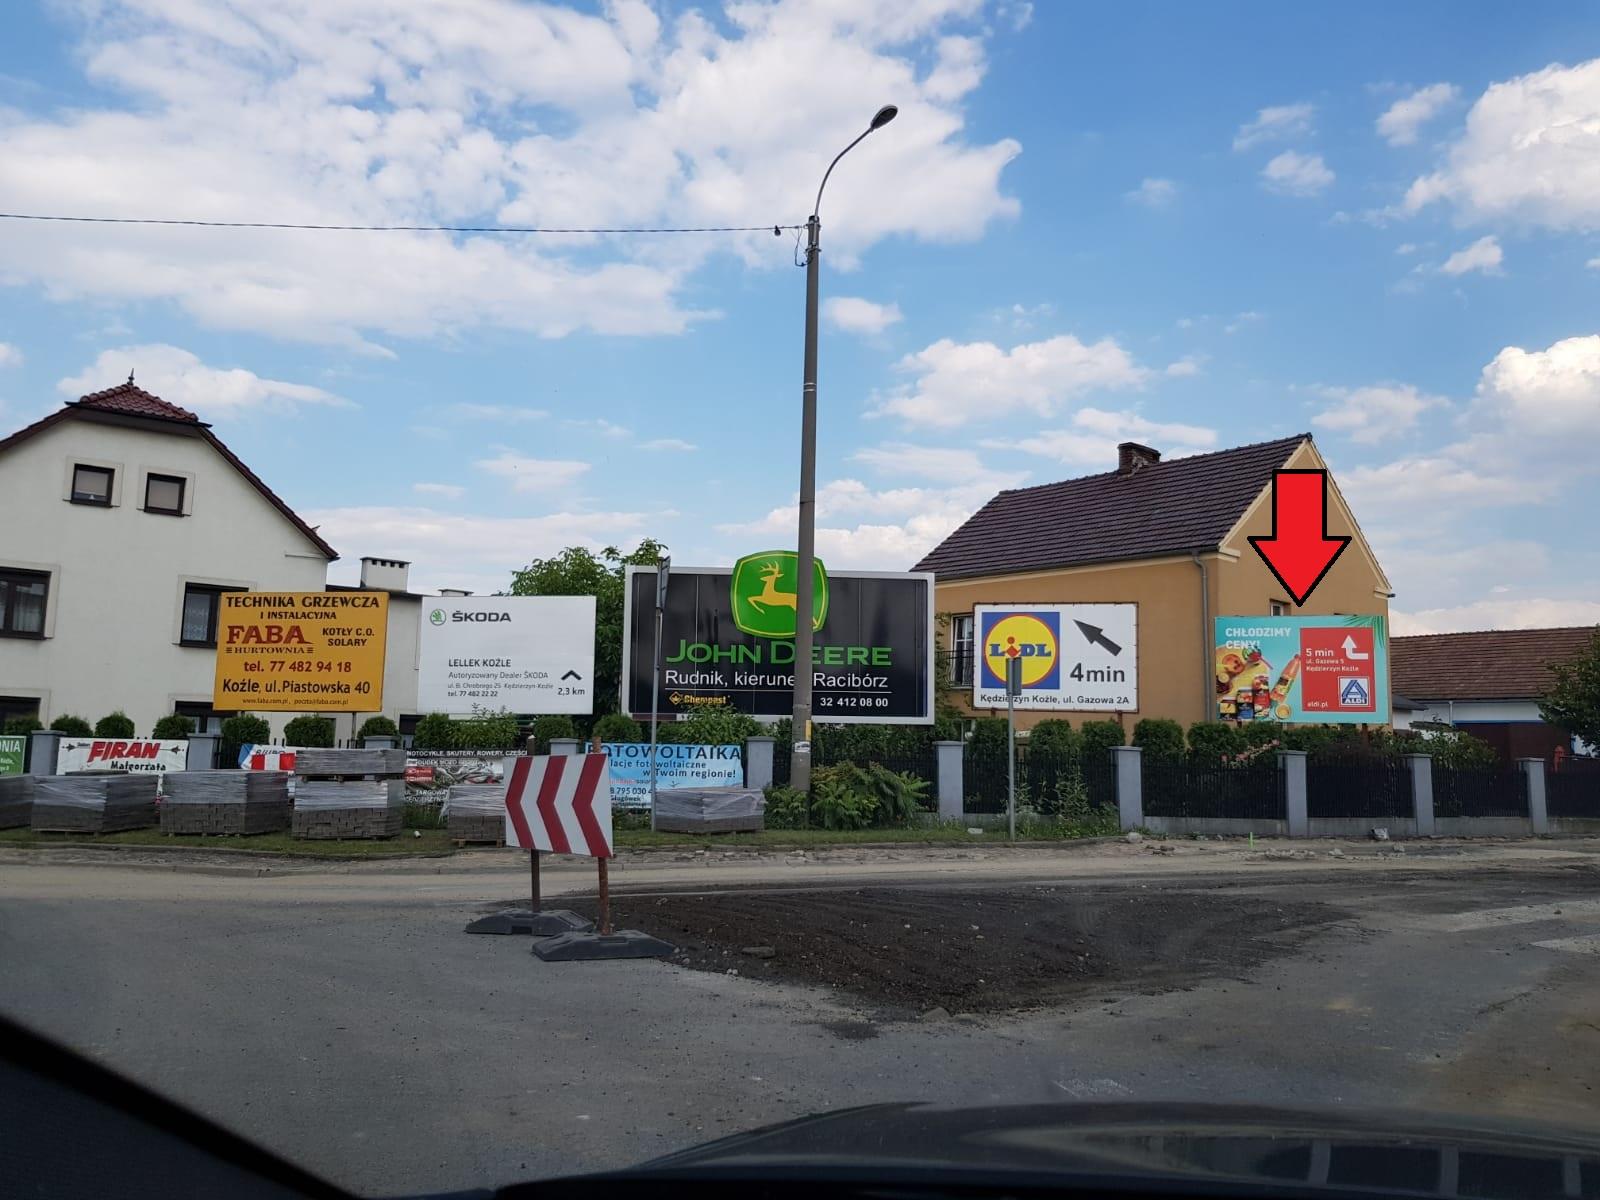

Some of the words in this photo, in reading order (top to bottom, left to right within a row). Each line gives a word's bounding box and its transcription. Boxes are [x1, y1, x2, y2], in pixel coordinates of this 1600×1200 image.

[227, 597, 295, 608] TECHNIKA
[302, 597, 379, 608] GRZEWCZA
[452, 610, 512, 622] ŠKODA
[226, 625, 311, 645] FABA
[322, 627, 352, 637] KOTŁY
[356, 628, 375, 637] C.O.
[1225, 627, 1292, 638] CHŁODZIMY
[328, 638, 367, 647] SOLARY
[1225, 640, 1261, 650] CENY!
[666, 640, 761, 664] JOHN
[1306, 648, 1312, 657] 5
[1315, 648, 1334, 657] min
[244, 661, 264, 672] tel.
[269, 661, 286, 672] 77
[288, 661, 312, 673] 482
[317, 661, 332, 672] 94
[337, 662, 352, 673] 18
[448, 659, 480, 667] LELLEK
[483, 658, 511, 667] KOŹLE
[448, 671, 498, 680] Autoryzowany
[524, 671, 549, 679] ŠKODA
[665, 670, 728, 686] Rudnik,
[734, 671, 796, 686] kierune
[814, 673, 888, 688] Racibórz
[223, 678, 261, 694] Koźle,
[354, 681, 370, 694] 40
[558, 688, 570, 696] 2,3
[572, 687, 585, 696] km
[820, 698, 833, 707] 32
[837, 698, 857, 707] 412
[860, 698, 873, 707] 08
[875, 698, 888, 707] 00
[1032, 694, 1061, 704] Koźle,
[1063, 695, 1074, 704] ul.
[1077, 696, 1114, 704] Gazowa
[1117, 696, 1130, 704] 2A
[0, 740, 21, 752] NIA
[87, 741, 161, 763] FIRAN
[111, 761, 166, 771] Małgorzata
